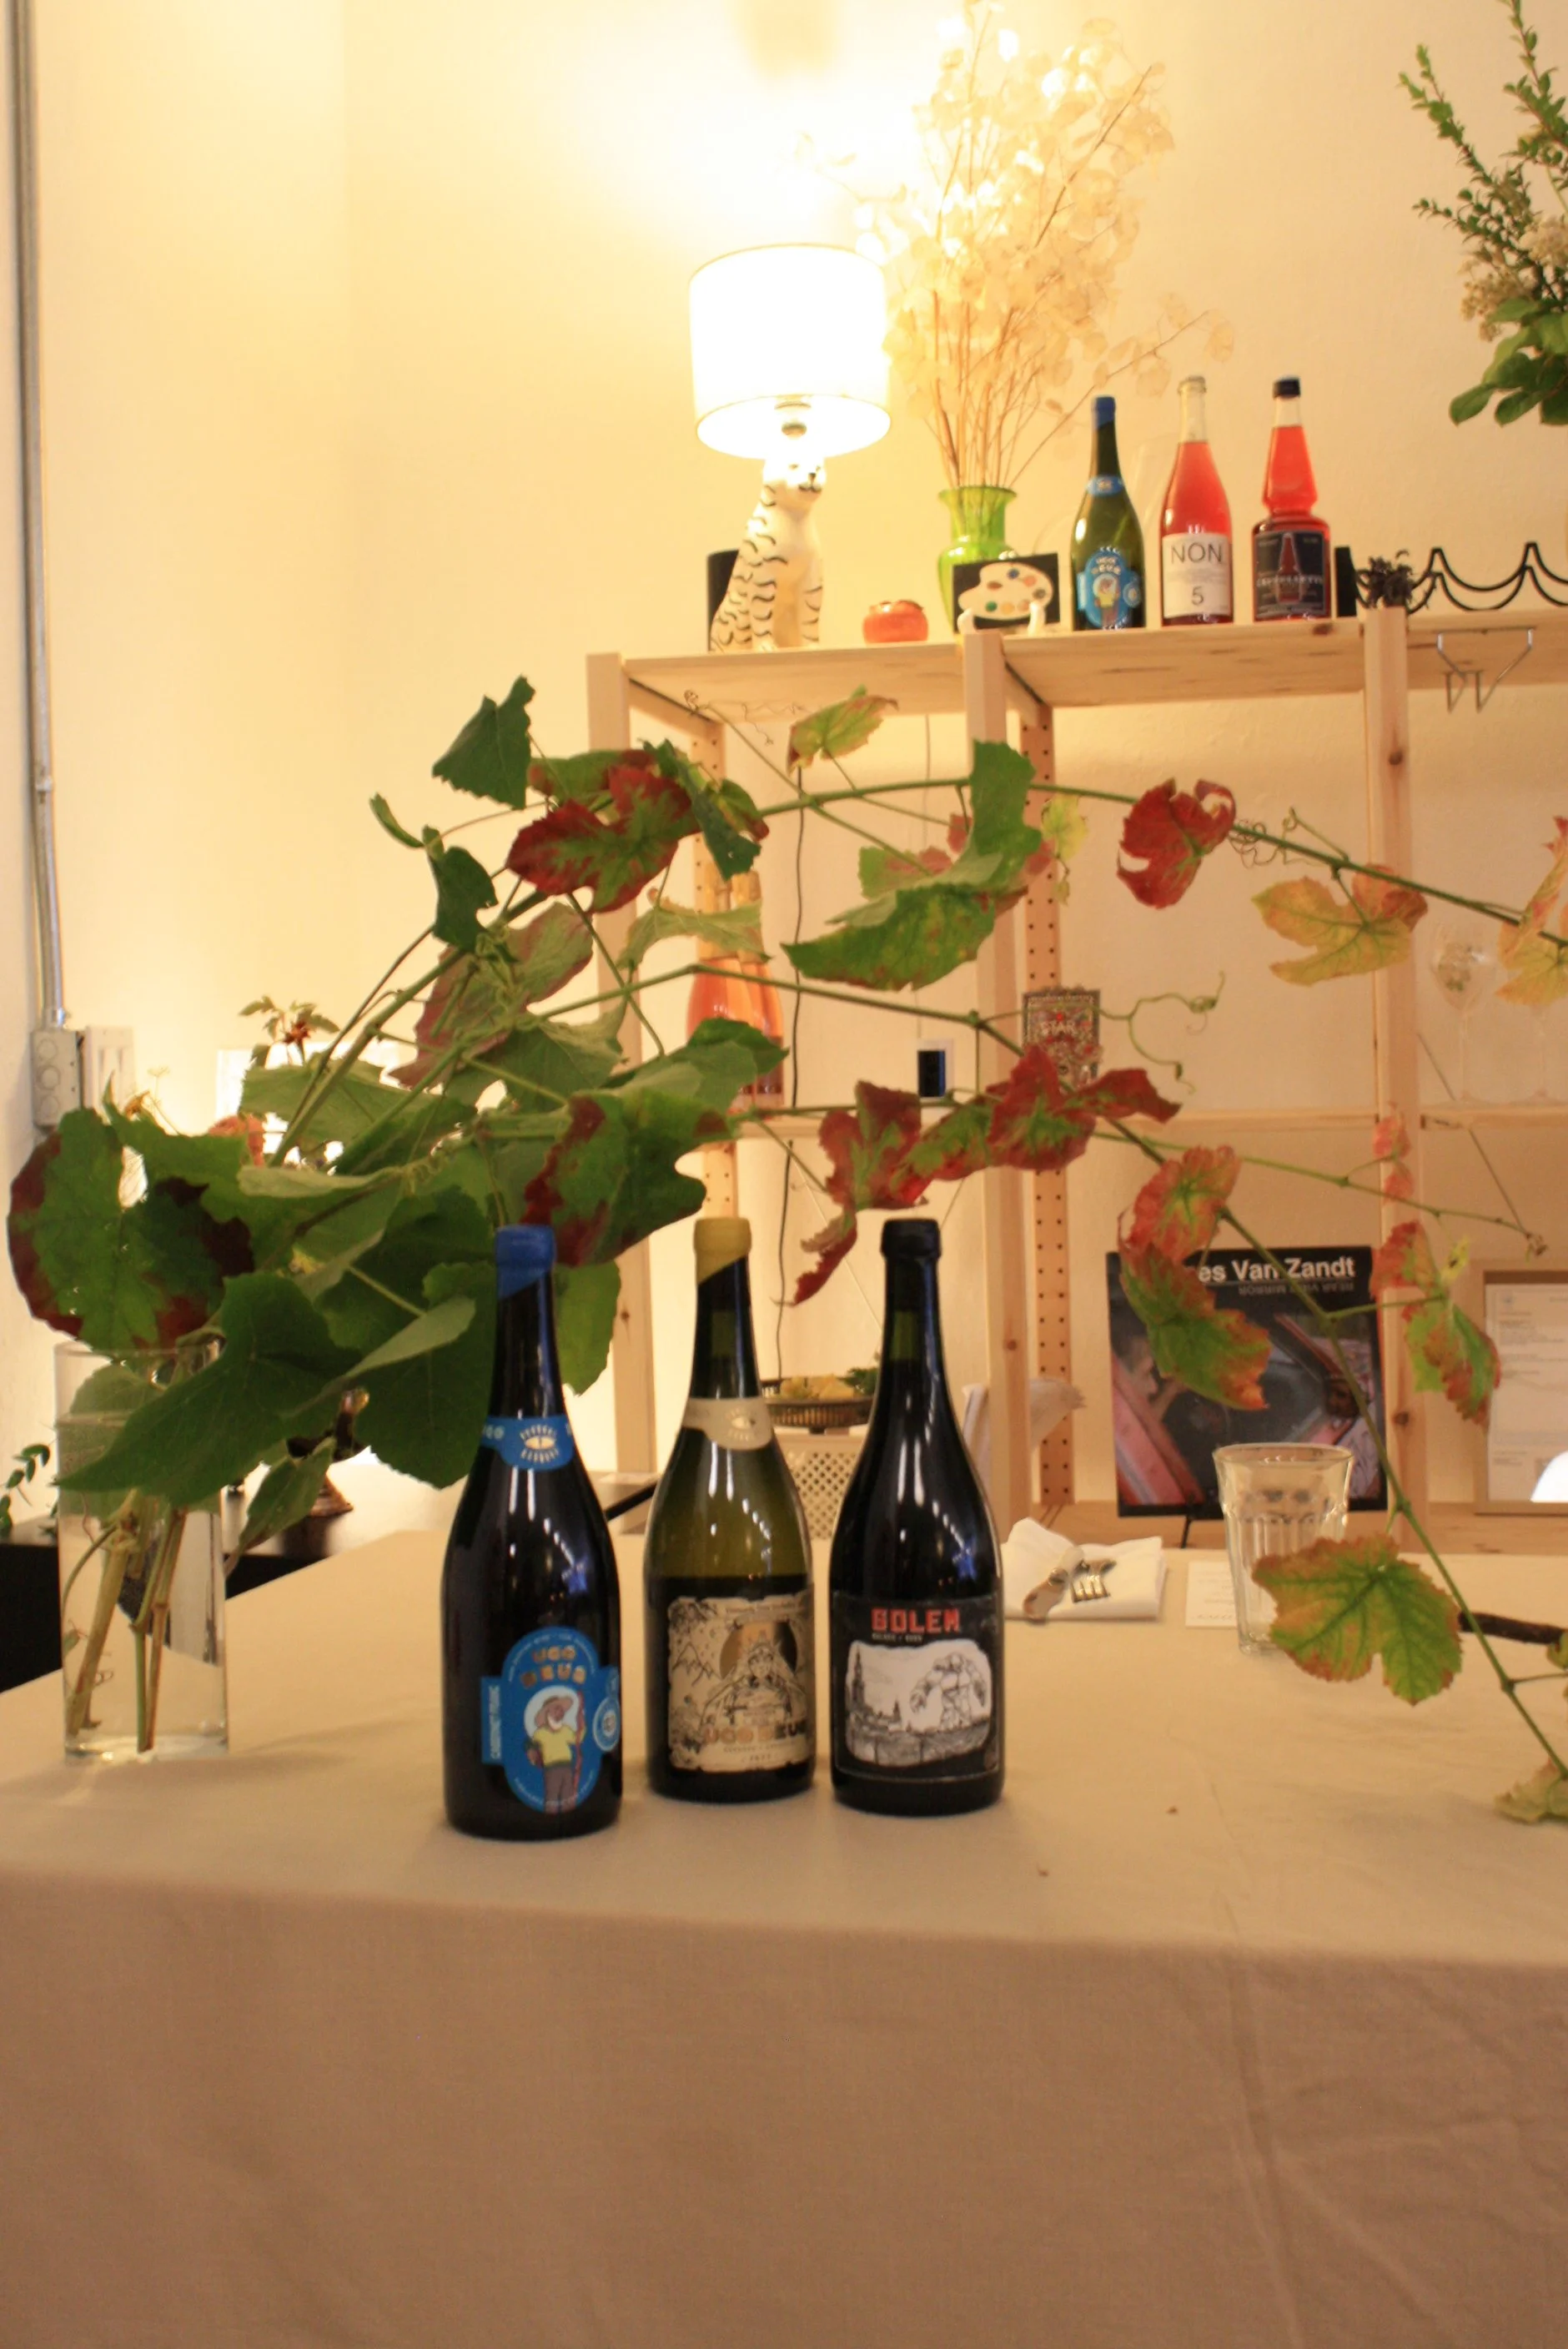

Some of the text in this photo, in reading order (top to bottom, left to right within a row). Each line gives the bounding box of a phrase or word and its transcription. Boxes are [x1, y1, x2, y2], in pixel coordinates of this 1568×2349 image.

[1171, 542, 1222, 565] NON
[1191, 586, 1204, 606] 5
[1231, 1259, 1279, 1281] Van
[1284, 1255, 1355, 1279] Zandt
[871, 1607, 961, 1633] GOLEM
